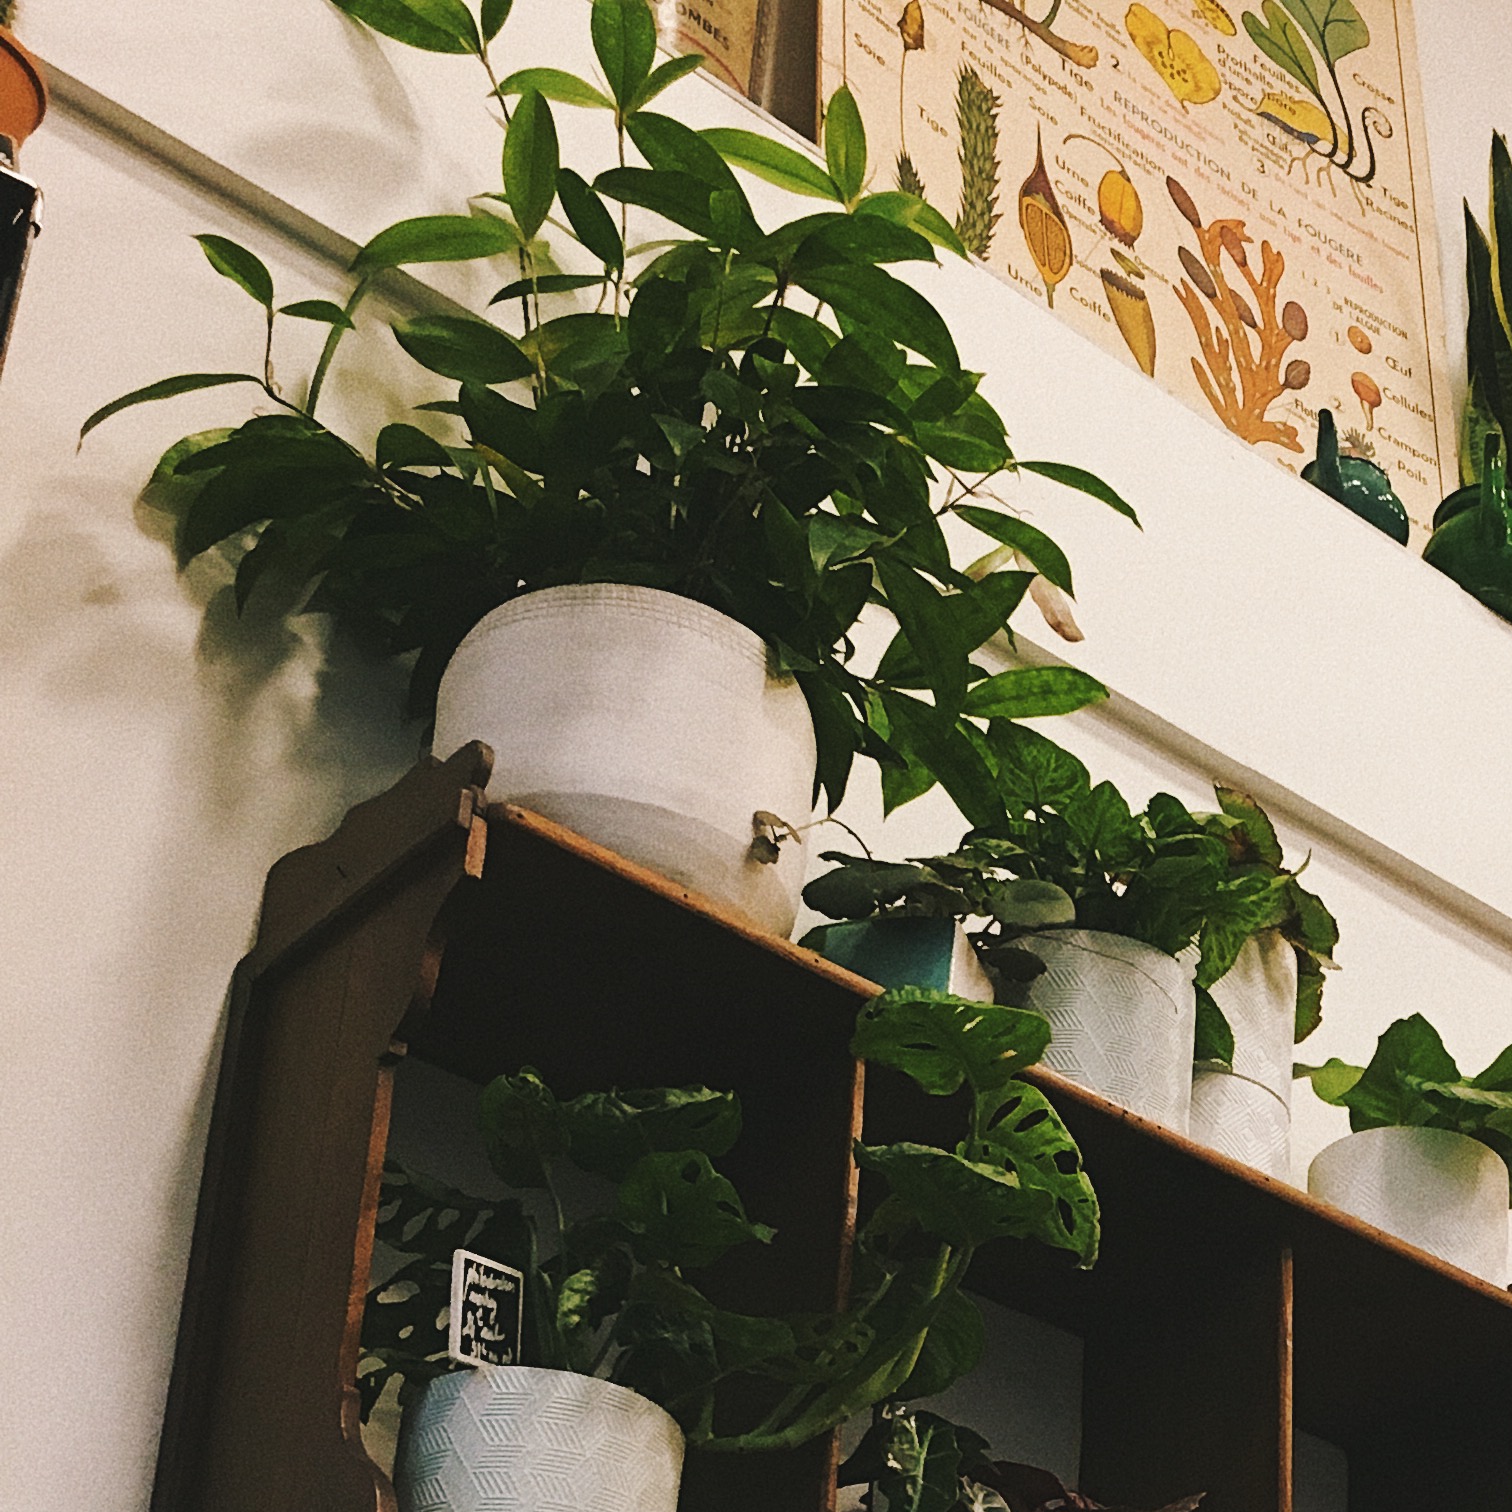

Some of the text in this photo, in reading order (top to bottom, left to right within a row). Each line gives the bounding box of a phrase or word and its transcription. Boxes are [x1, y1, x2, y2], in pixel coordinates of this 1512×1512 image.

[676, 3, 730, 51] OMBES
[855, 32, 885, 66] Soie
[961, 41, 1013, 89] Feuilles
[1217, 43, 1274, 90] Prothalle
[1059, 55, 1094, 92] Tige
[1220, 72, 1258, 106] Spore
[1253, 53, 1302, 95] Feuilles
[917, 103, 948, 137] Tige
[1029, 96, 1058, 126] Soie
[1080, 105, 1166, 176] Fructification
[1114, 90, 1231, 182] REPRODUCTION
[1241, 181, 1259, 201] DE
[1269, 200, 1288, 220] LA
[1055, 154, 1089, 188] Urne
[1054, 179, 1096, 216] Coiffe
[1365, 196, 1416, 234] Racines
[1380, 185, 1409, 211] Tige
[1008, 263, 1043, 298] Urne
[1069, 286, 1111, 323] Coiffe
[1385, 354, 1412, 379] Œuf
[1383, 387, 1434, 423] Cellules
[1377, 426, 1438, 467] Crampon
[1397, 460, 1428, 486] Poils
